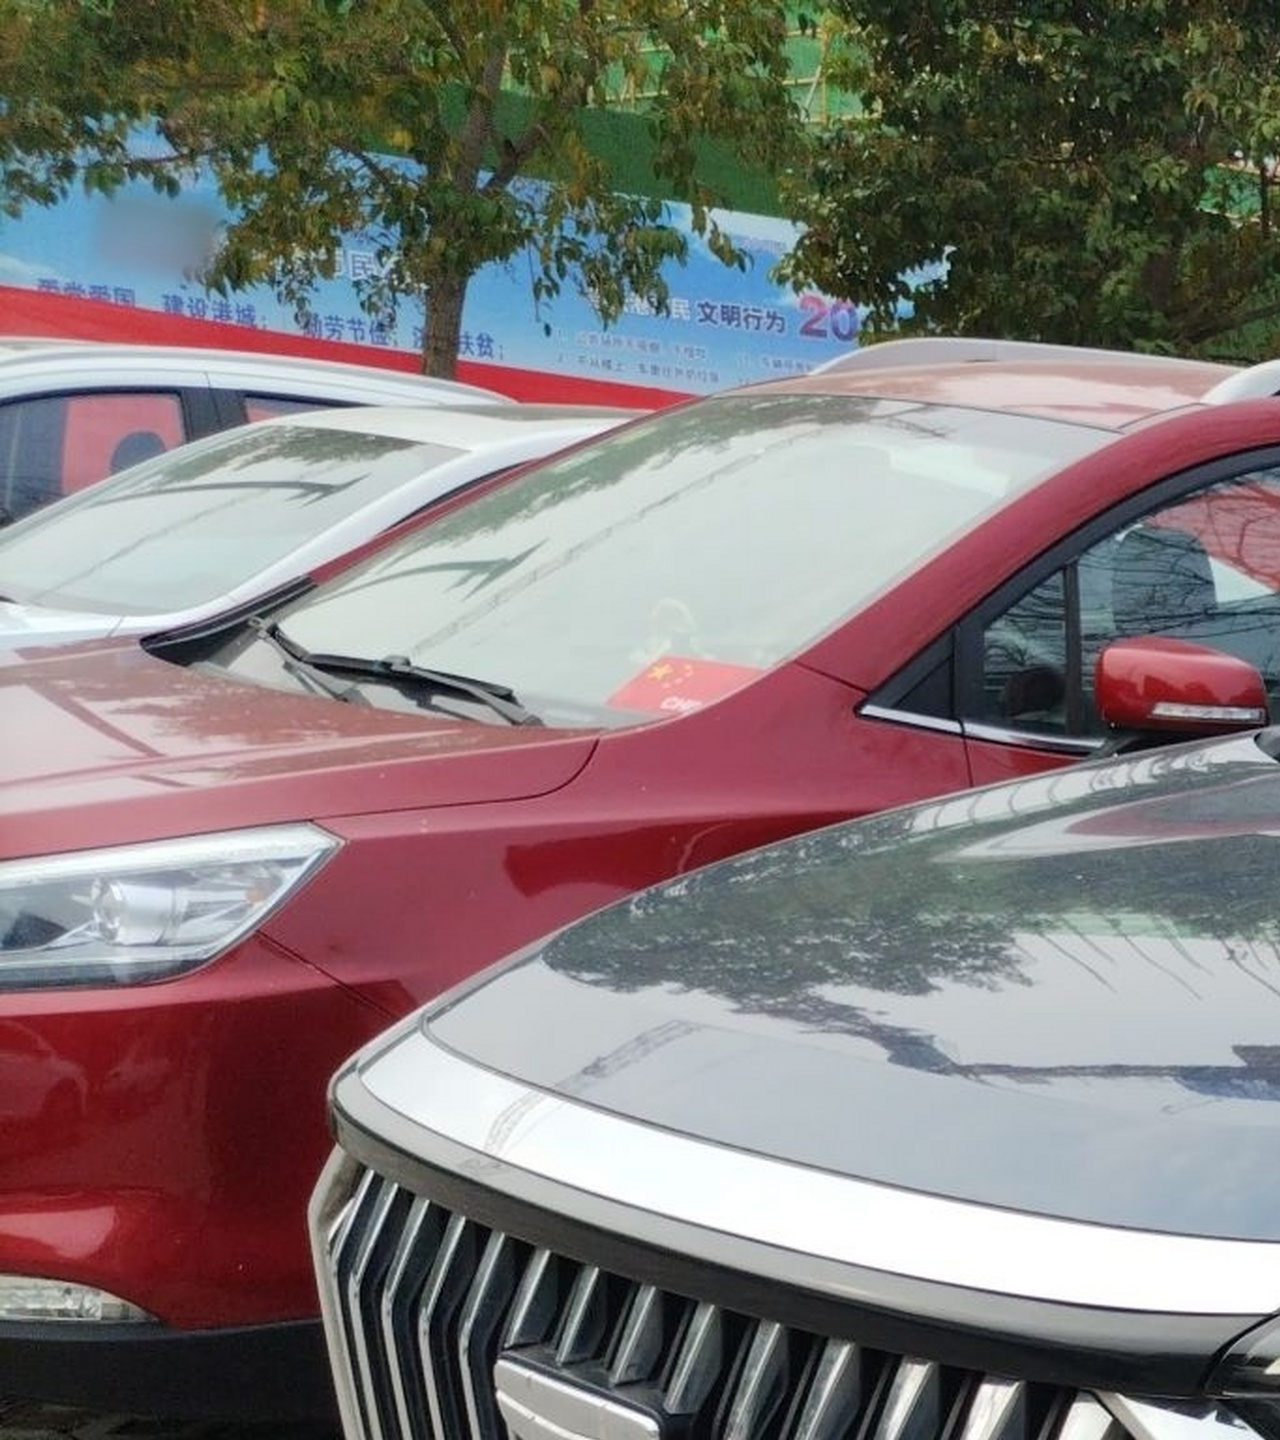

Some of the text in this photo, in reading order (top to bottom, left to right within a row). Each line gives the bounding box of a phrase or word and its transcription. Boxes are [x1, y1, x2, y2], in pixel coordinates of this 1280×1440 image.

[697, 300, 786, 334] 文明行为
[799, 293, 860, 341] 20
